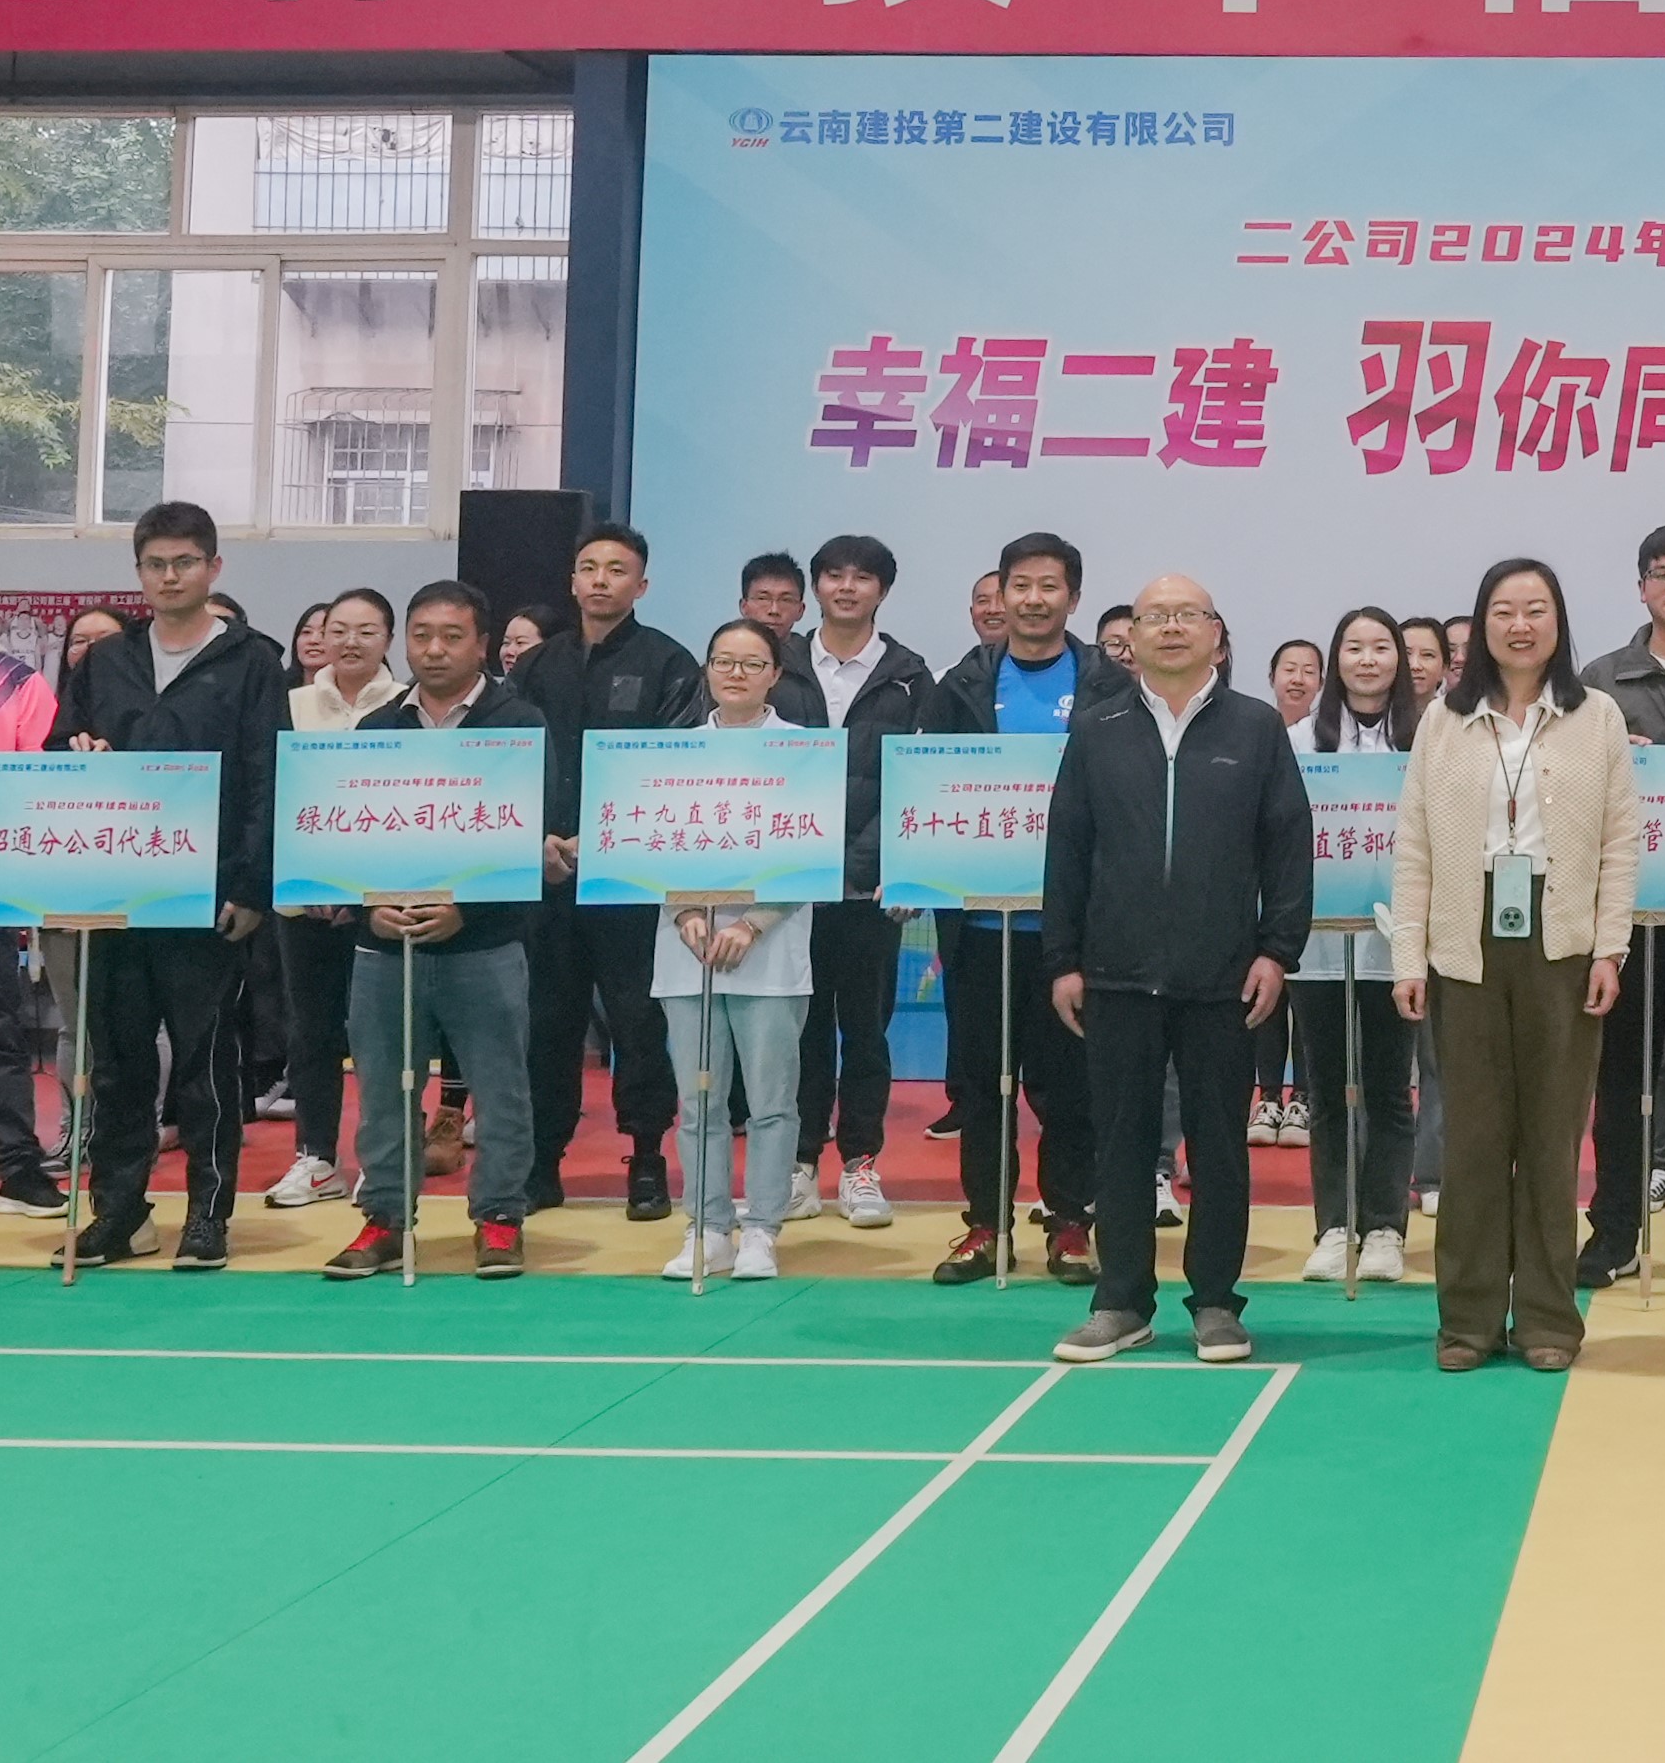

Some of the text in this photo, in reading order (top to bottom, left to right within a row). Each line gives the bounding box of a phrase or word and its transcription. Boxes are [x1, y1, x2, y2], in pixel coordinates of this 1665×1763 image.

[779, 110, 1234, 147] 云南建投第二建设有限公司
[810, 335, 1280, 469] 幸福二建
[296, 800, 523, 834] 绿化分公司代表队
[598, 801, 762, 826] 第十九直管部
[768, 813, 824, 840] 联队
[596, 829, 761, 853] 第一安装分公司
